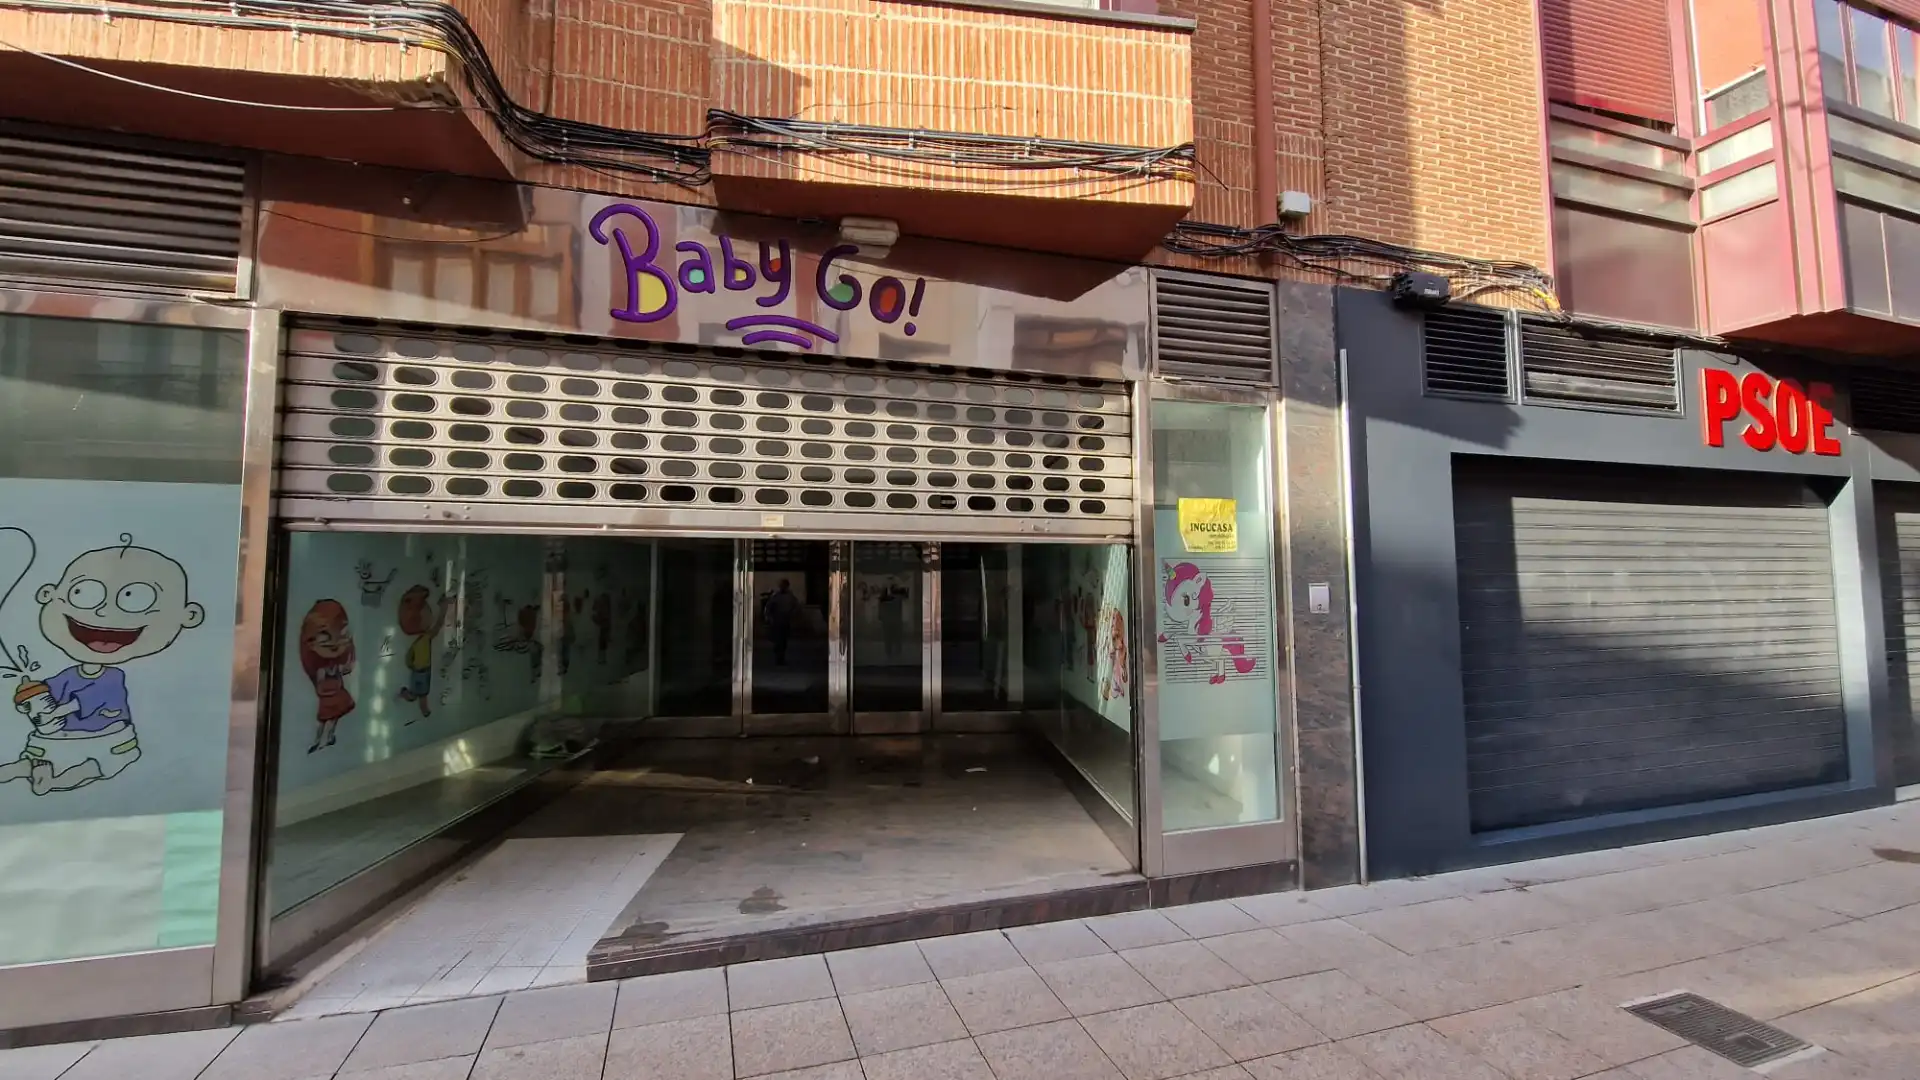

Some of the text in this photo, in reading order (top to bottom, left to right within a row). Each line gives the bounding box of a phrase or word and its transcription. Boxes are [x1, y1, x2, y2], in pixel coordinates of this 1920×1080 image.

[588, 203, 792, 323] Baby
[1699, 367, 1841, 456] PSOE
[1190, 522, 1233, 532] INGUCASA
